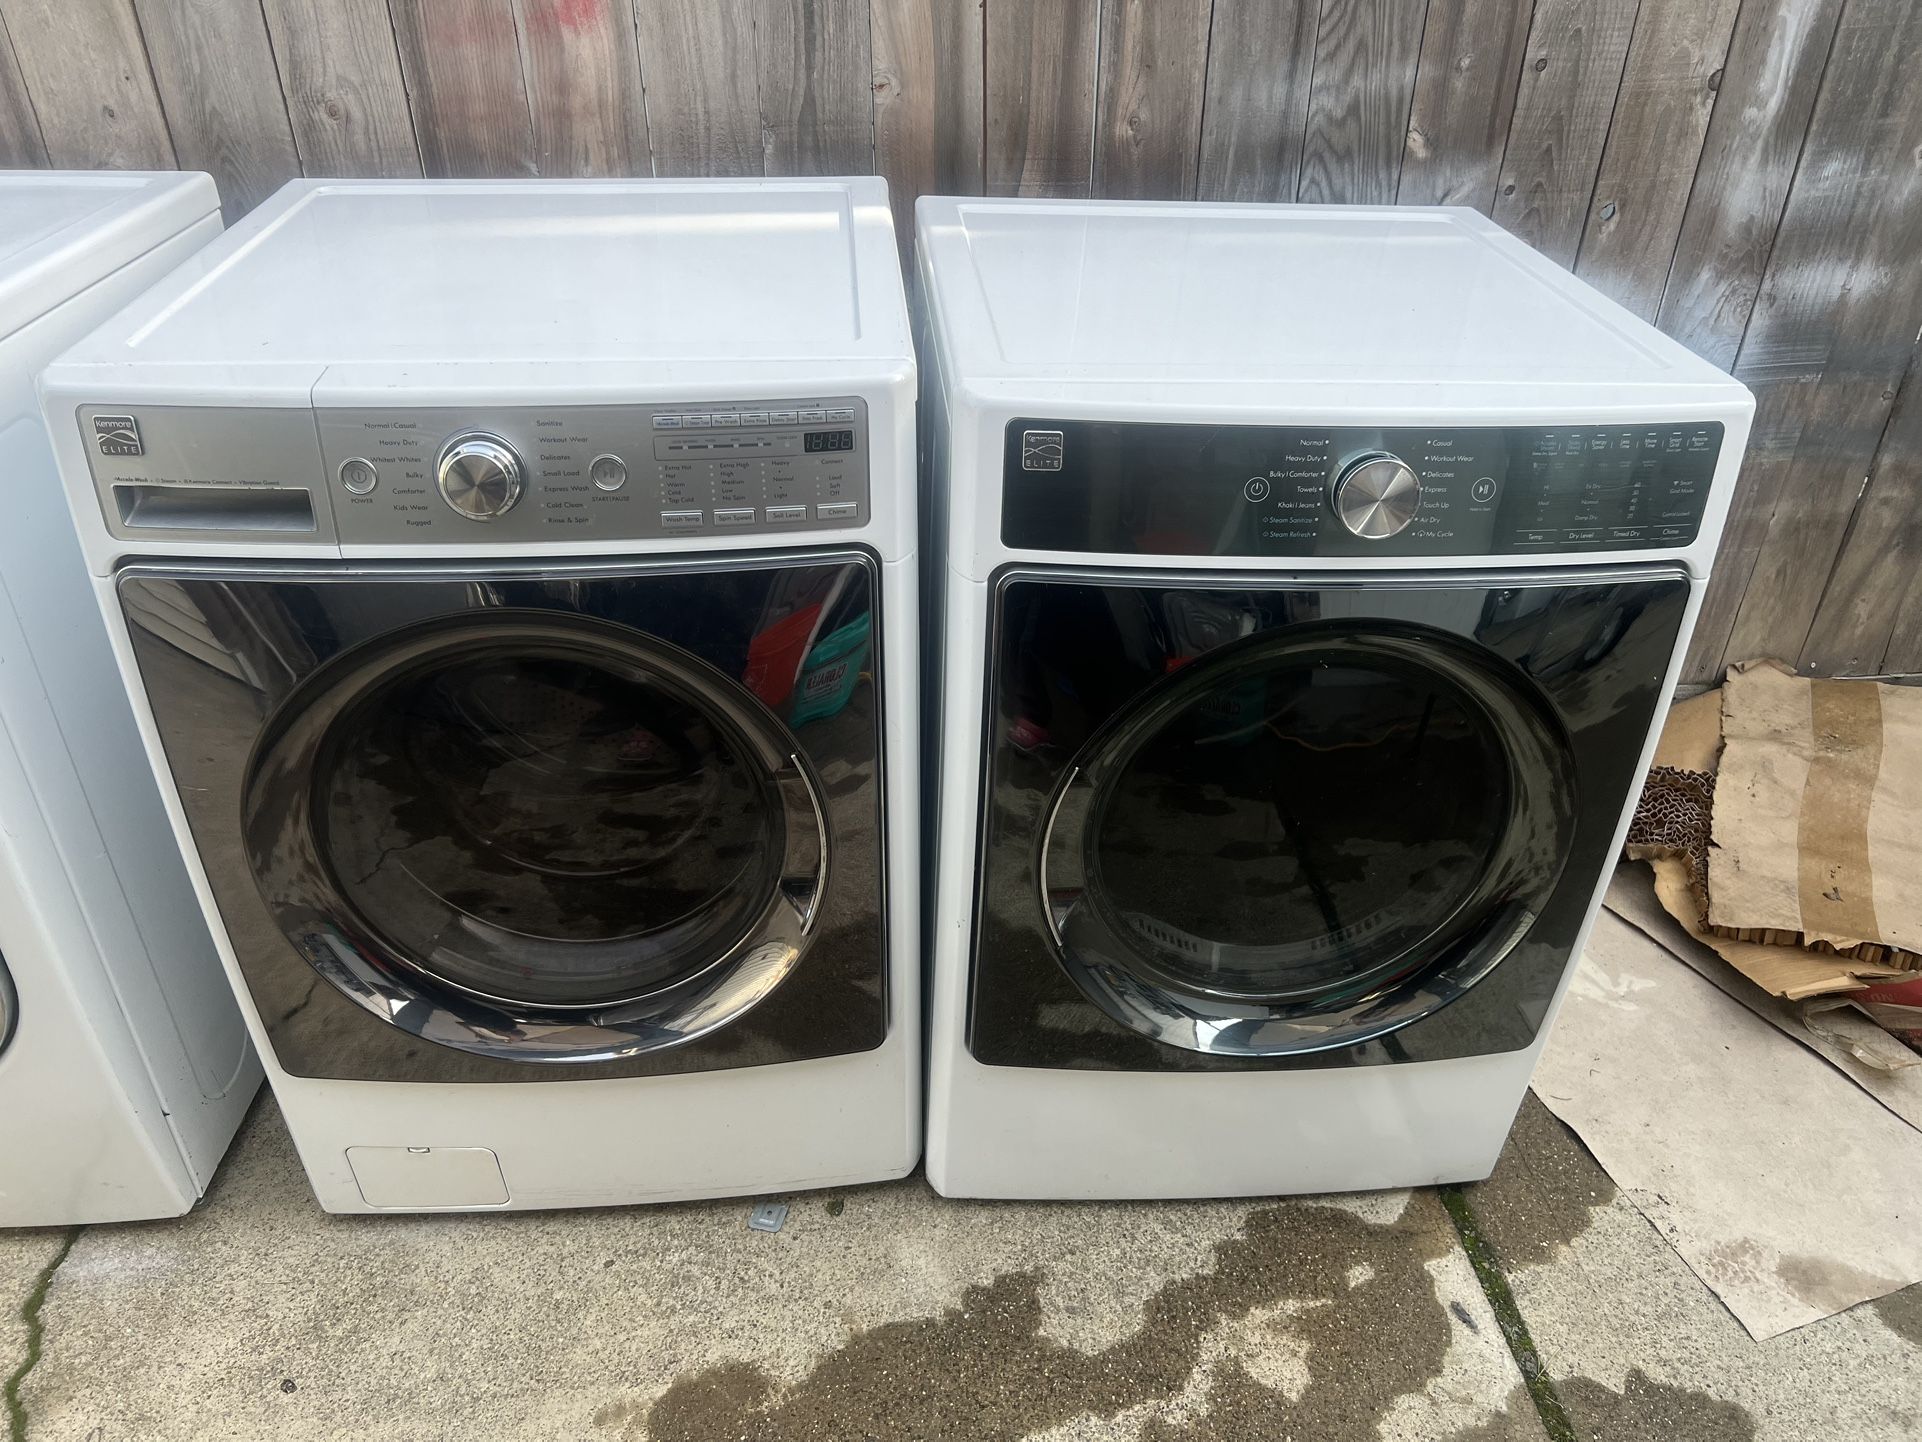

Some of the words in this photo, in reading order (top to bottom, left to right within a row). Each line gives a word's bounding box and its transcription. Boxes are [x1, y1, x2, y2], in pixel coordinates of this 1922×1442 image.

[96, 419, 132, 428] Kenmore
[539, 436, 567, 444] Workout
[1026, 434, 1060, 443] Kenmore
[379, 439, 401, 447] Heavy
[402, 439, 419, 447] Duty
[1432, 439, 1453, 447] Casual
[102, 445, 138, 454] ELITE
[1285, 454, 1306, 462] Heavy
[1306, 454, 1322, 462] Duty
[736, 461, 750, 470] High
[1025, 459, 1059, 468] ELITE
[405, 471, 424, 479] Bulky
[563, 469, 580, 477] Load
[1269, 470, 1285, 478] Bulky
[1289, 470, 1319, 478] Comforter
[392, 487, 426, 495] Comforter
[544, 485, 569, 493] Express
[1424, 486, 1447, 494] Express
[1277, 501, 1295, 509] Khaki
[1298, 501, 1315, 509] Jeans
[1423, 501, 1440, 509] Touch
[1440, 501, 1450, 510] Up
[574, 516, 590, 525] Spin
[683, 515, 700, 523] Temp
[733, 513, 753, 521] Speed
[1429, 516, 1441, 524] Dry
[406, 519, 432, 527] Rugged
[1436, 531, 1454, 539] Cycle
[1528, 533, 1544, 541] Temp
[1568, 532, 1580, 540] Dry
[1580, 531, 1595, 539] Level
[1630, 530, 1641, 538] Dry
